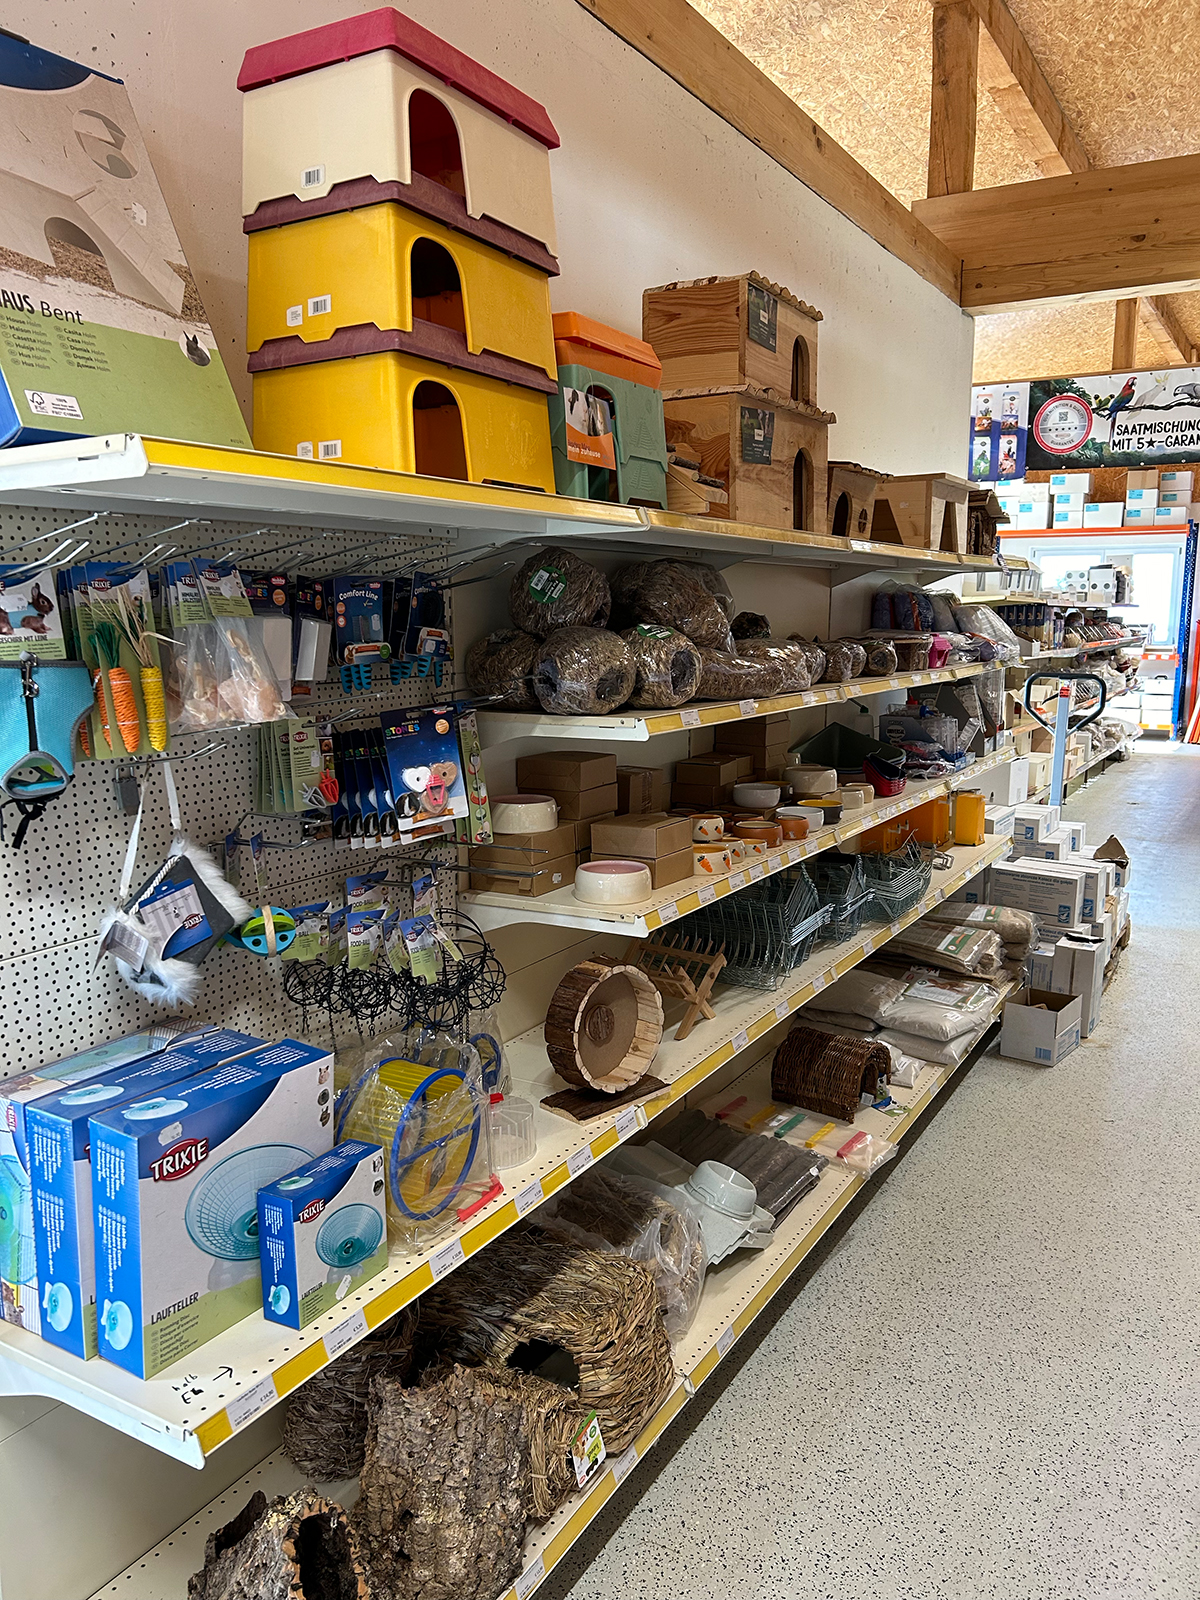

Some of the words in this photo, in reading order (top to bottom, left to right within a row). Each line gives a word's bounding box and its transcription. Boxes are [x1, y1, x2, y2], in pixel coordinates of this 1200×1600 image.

[40, 301, 84, 325] Bent
[1112, 438, 1133, 451] MIT
[201, 571, 220, 580] TRIXIE
[90, 580, 112, 589] TRIXIE
[246, 588, 268, 597] ONES
[338, 589, 365, 600] Comfort
[366, 590, 378, 600] Line
[385, 724, 420, 736] STONES
[184, 914, 204, 930] TRIXIE
[8, 1104, 16, 1132] TRIXIE
[150, 1138, 208, 1180] TRIXIE
[298, 1200, 325, 1224] TRIXIE
[151, 1292, 199, 1326] LAUFTELLER
[160, 1320, 179, 1332] Running
